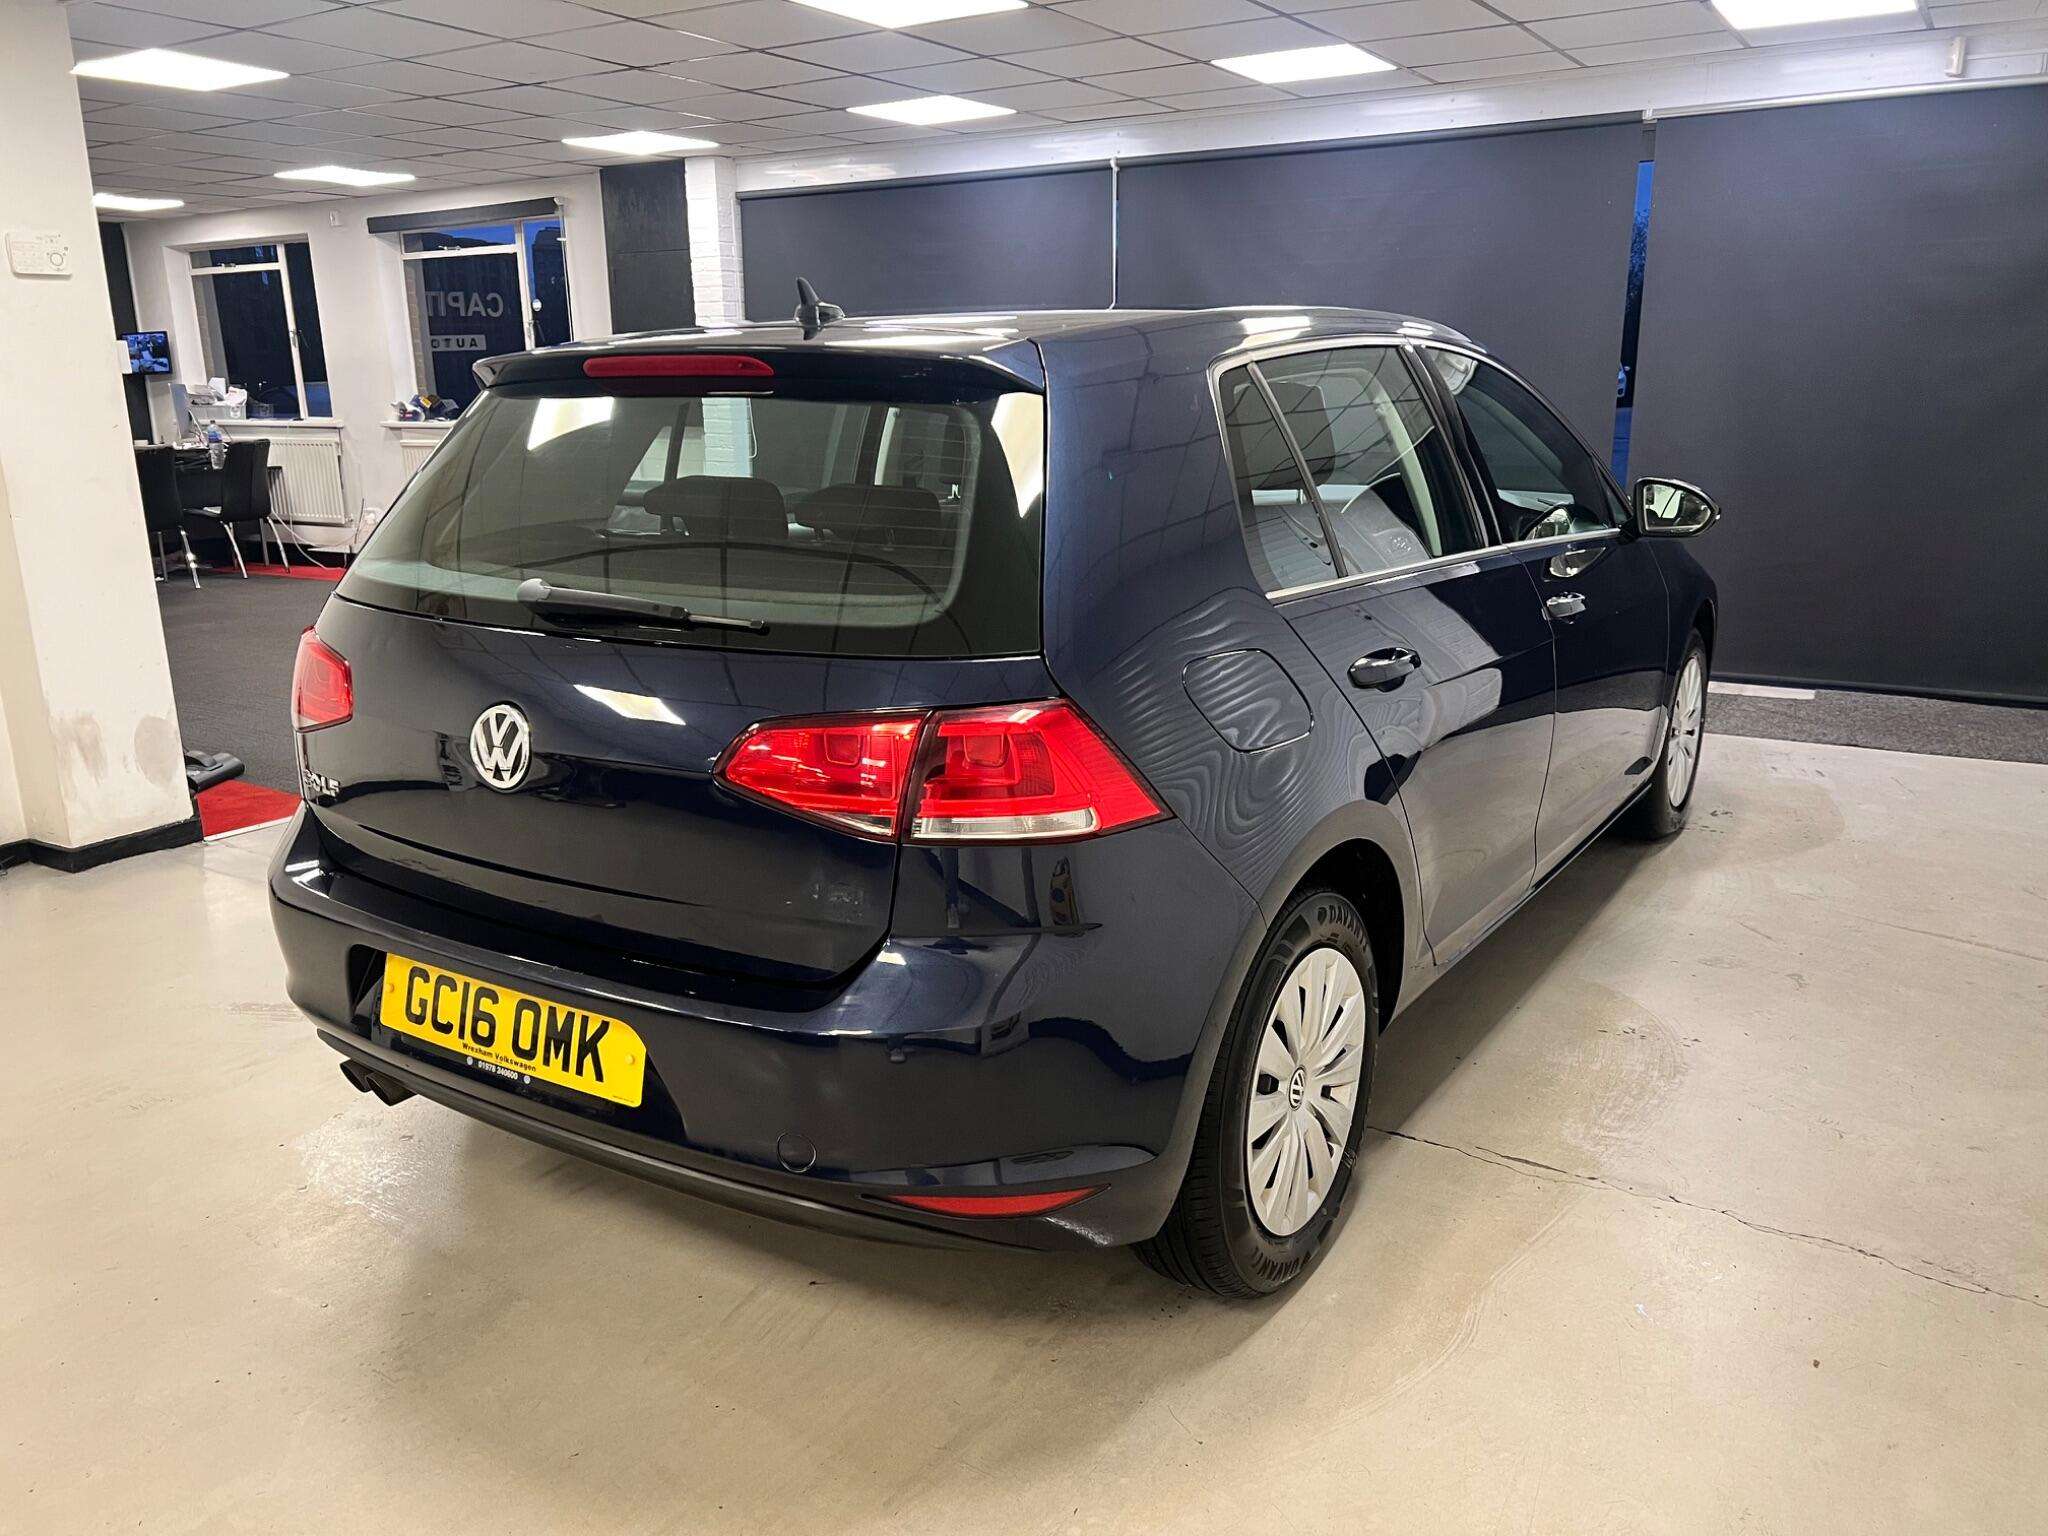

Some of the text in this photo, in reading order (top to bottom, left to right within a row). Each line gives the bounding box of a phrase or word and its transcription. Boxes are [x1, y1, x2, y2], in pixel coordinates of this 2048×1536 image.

[405, 966, 610, 1083] GC16 OMK
[462, 1042, 537, 1072] Wrexham Volkswagen
